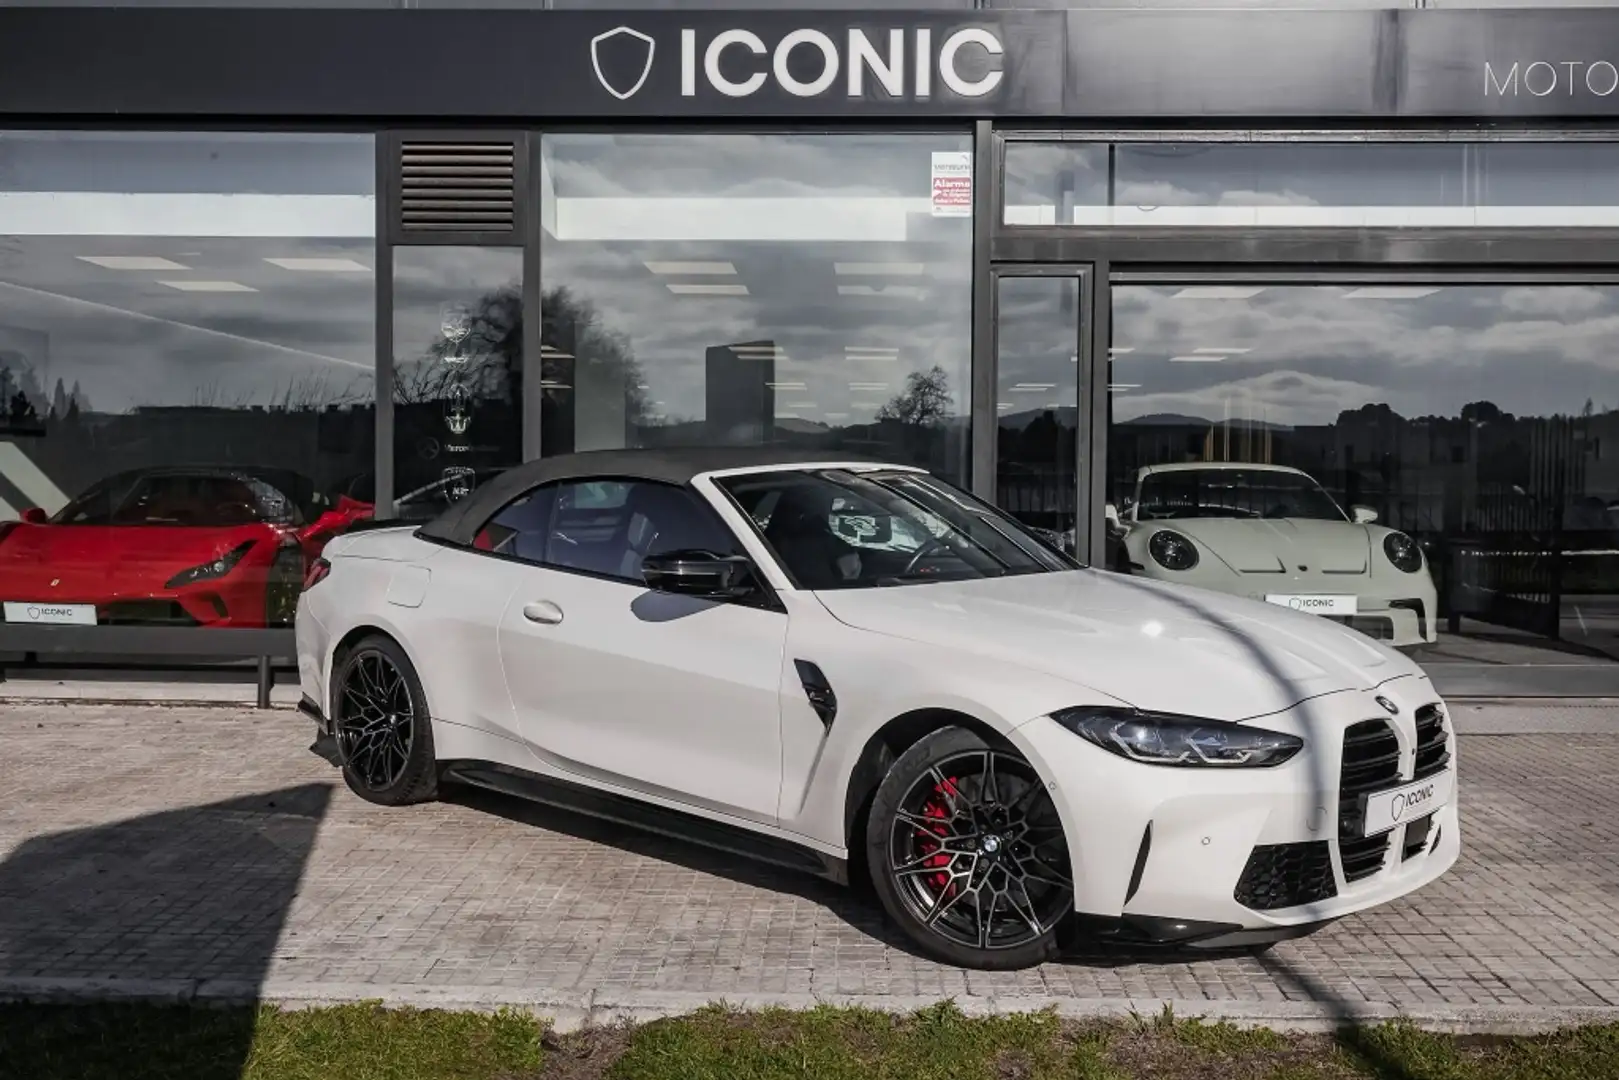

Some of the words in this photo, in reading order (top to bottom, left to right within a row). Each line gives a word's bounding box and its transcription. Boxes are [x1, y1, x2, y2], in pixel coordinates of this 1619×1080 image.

[681, 28, 1003, 96] ICONIC
[1484, 61, 1619, 96] MOTO
[41, 608, 72, 616] ICONIC
[1303, 599, 1334, 607] ICONIC
[1405, 784, 1434, 807] ICONIC
